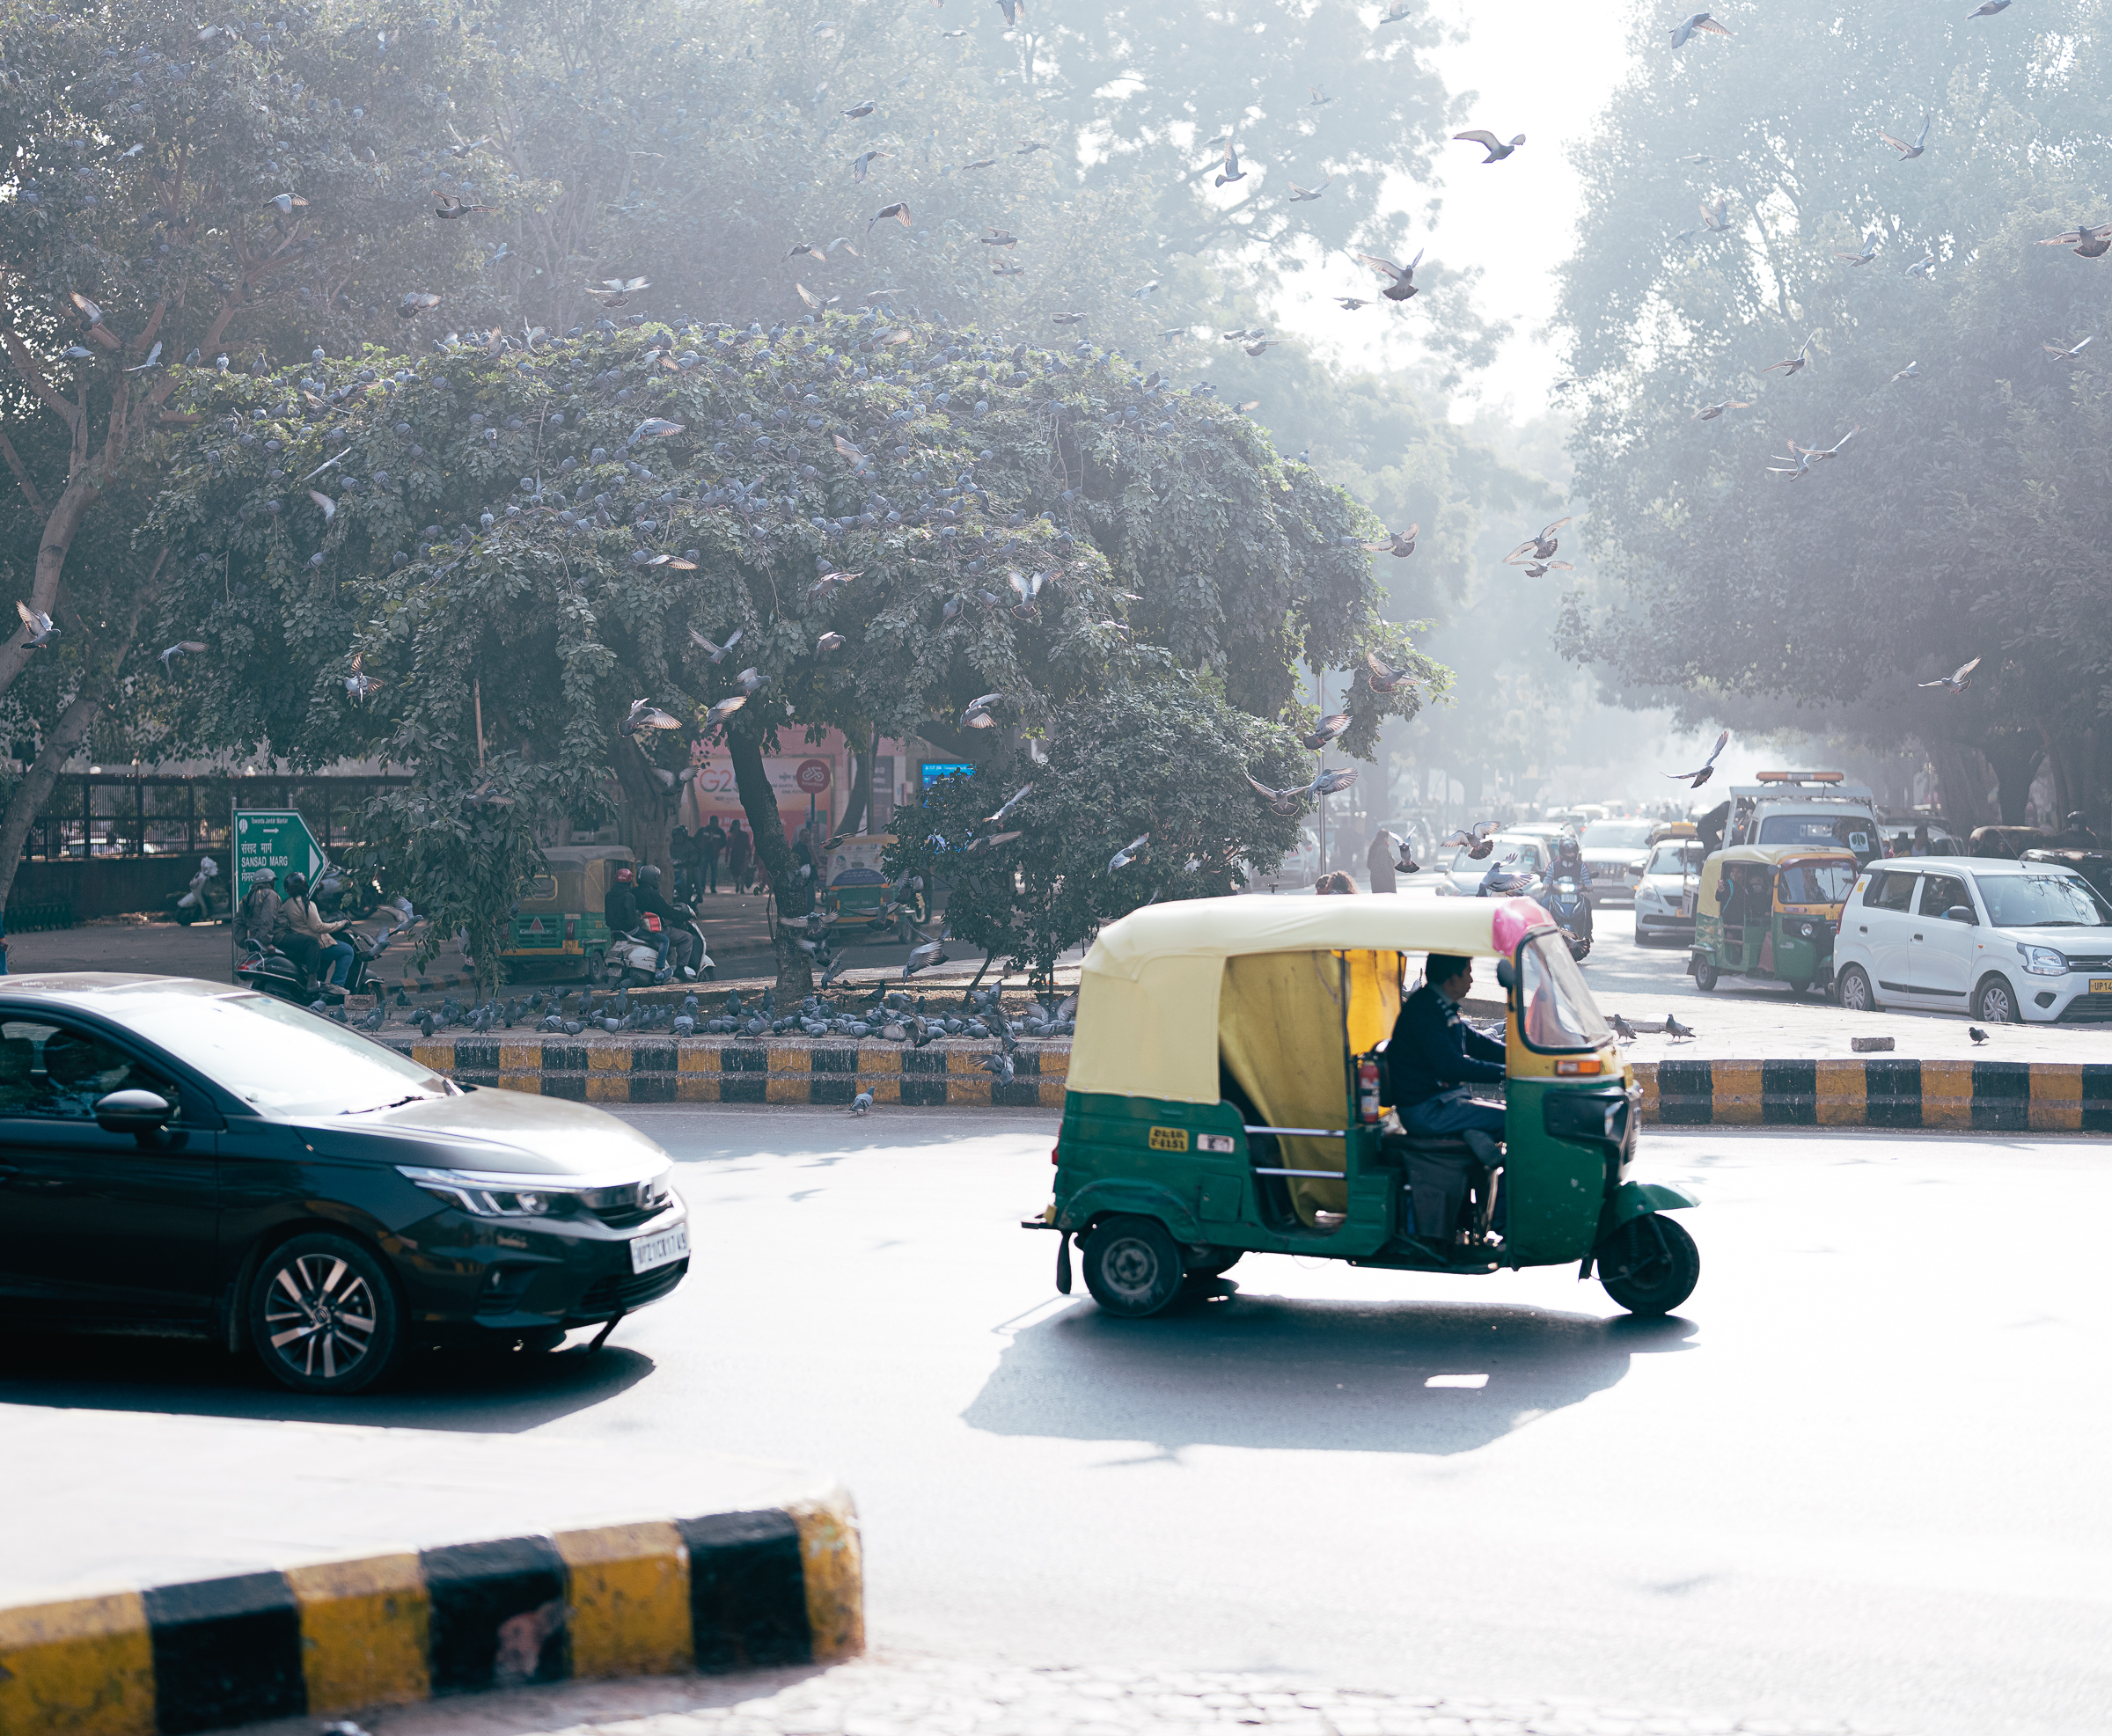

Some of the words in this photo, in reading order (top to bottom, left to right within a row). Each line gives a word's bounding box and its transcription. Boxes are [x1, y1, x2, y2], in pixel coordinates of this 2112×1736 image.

[241, 840, 257, 854] संसद
[260, 839, 273, 853] मार्ग
[241, 856, 267, 868] SANSAD
[269, 855, 288, 867] MARG
